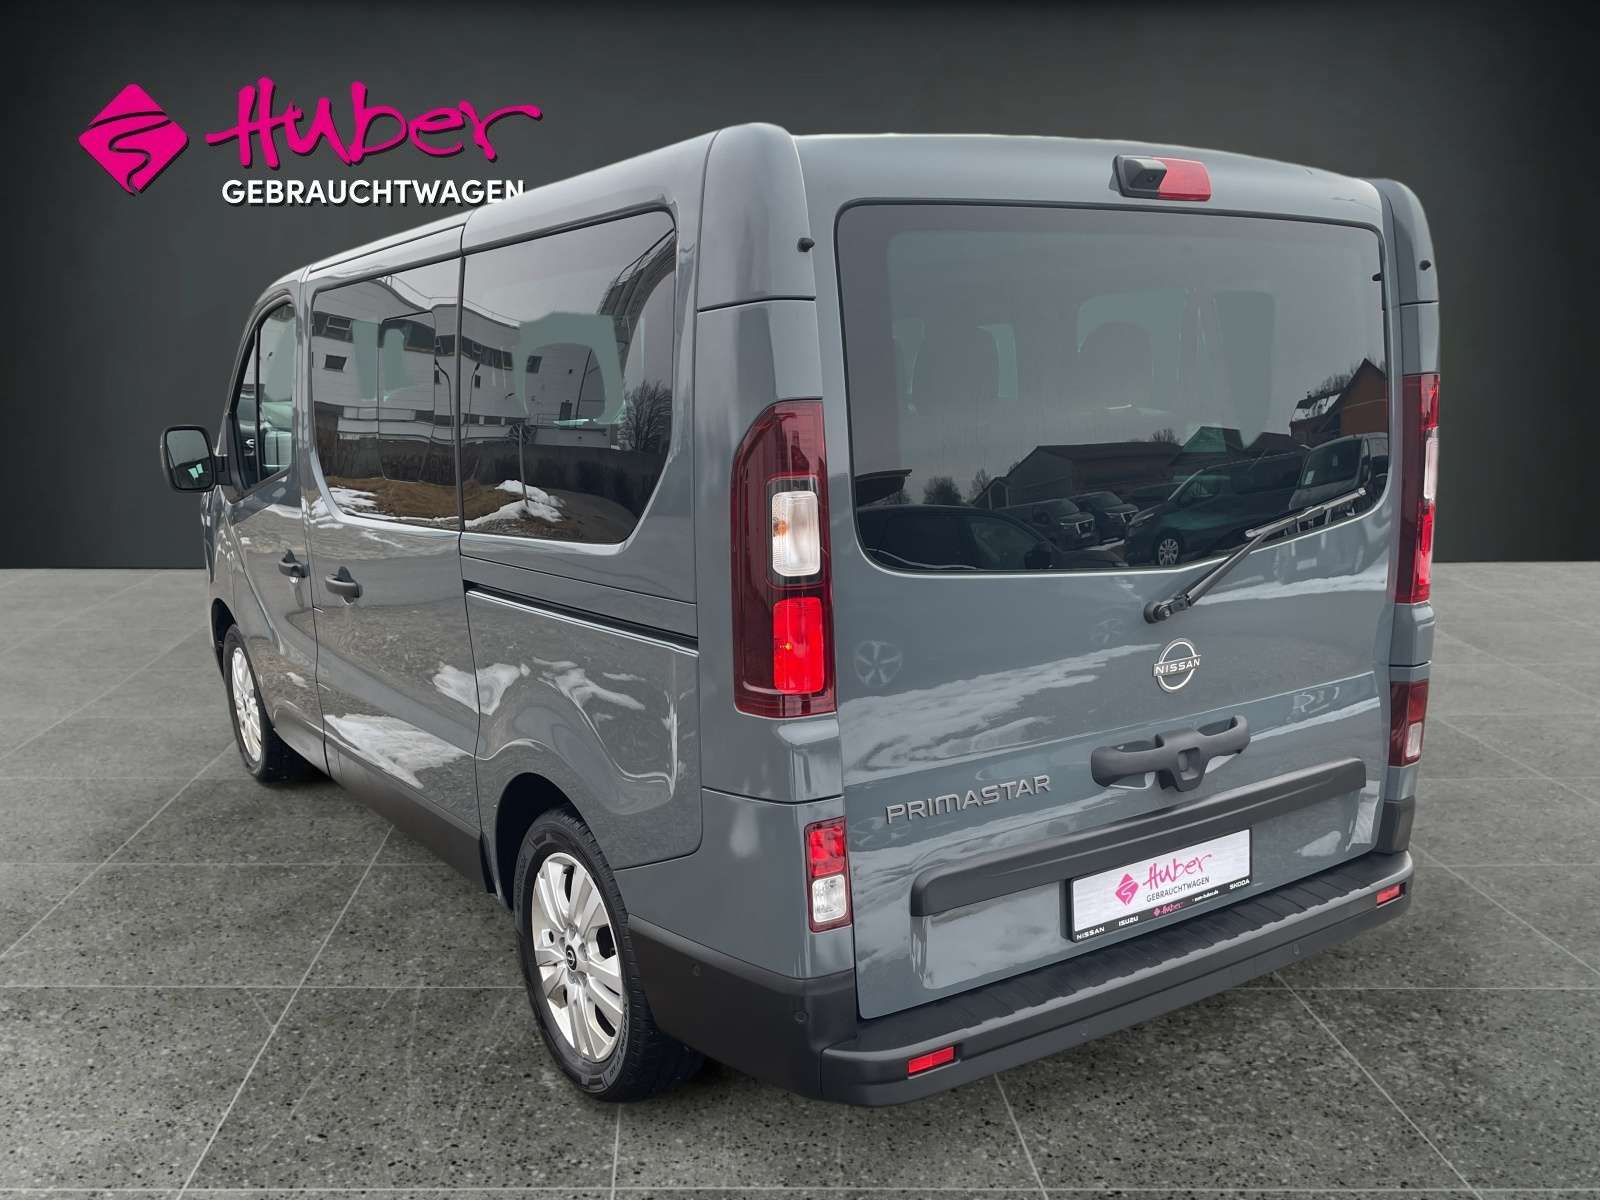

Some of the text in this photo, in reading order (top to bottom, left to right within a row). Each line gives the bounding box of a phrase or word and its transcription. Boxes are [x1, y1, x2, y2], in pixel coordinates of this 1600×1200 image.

[1155, 658, 1200, 675] NISSAN
[886, 774, 1051, 825] PRIMASTAR
[1142, 854, 1212, 890] Huber
[1146, 876, 1210, 903] GEBRAUCHTWAGEN
[1118, 915, 1139, 927] ISUZU
[1076, 926, 1105, 940] NISSAN
